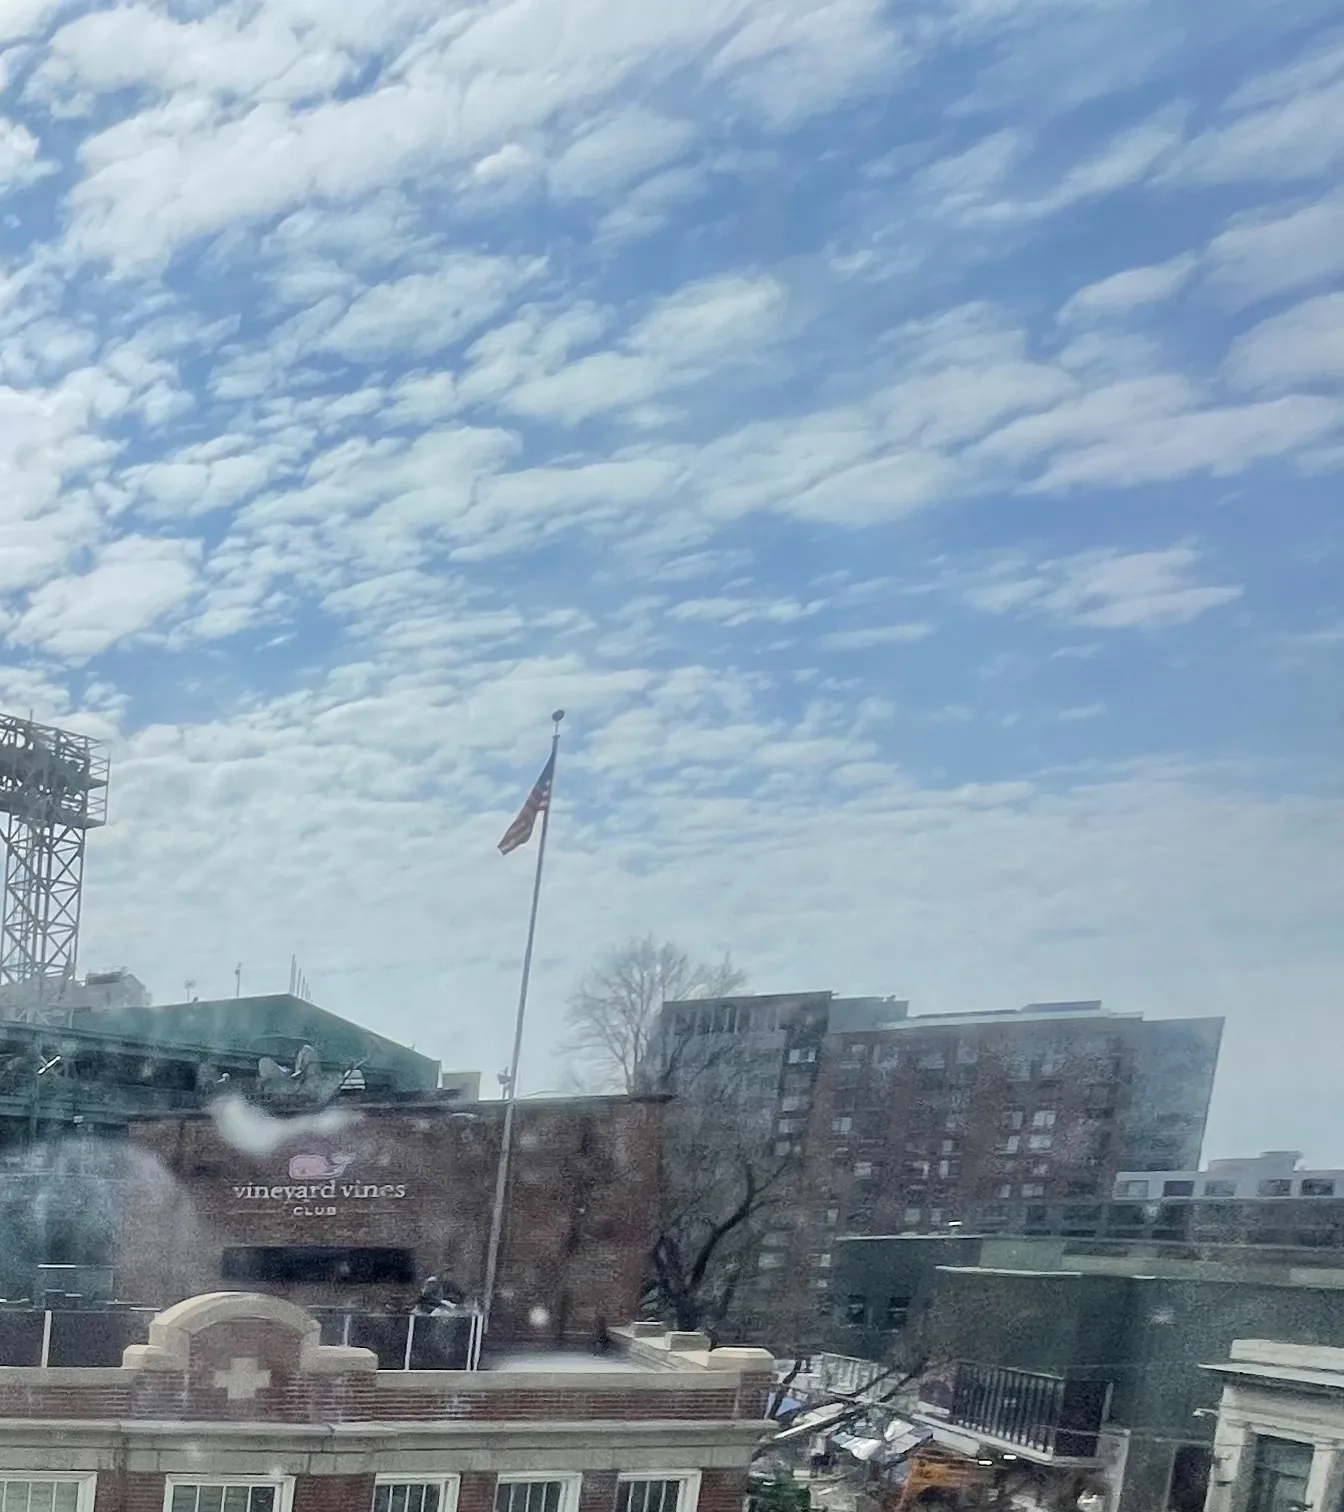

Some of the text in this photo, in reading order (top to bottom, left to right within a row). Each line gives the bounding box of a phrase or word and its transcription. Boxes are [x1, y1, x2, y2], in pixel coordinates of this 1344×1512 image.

[232, 1180, 406, 1204] vineyard vines
[293, 1206, 337, 1216] CLUB
